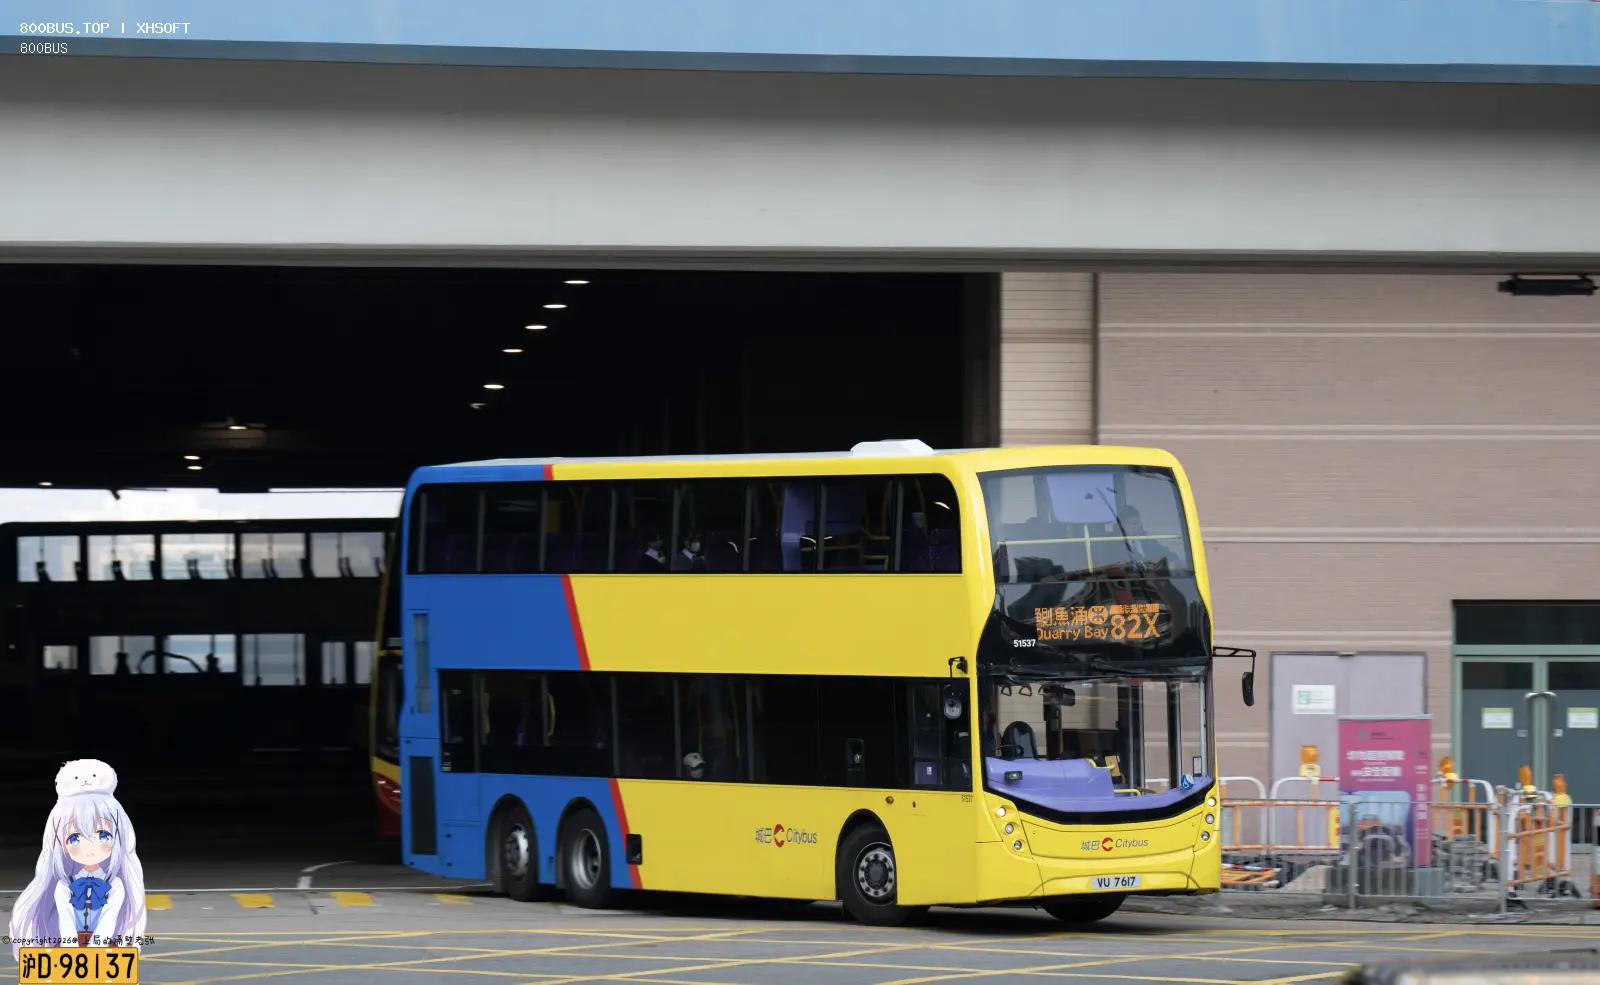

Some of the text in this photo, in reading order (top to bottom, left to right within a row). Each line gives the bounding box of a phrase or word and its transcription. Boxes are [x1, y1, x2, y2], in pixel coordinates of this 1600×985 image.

[1084, 625, 1108, 640] Bay
[1110, 613, 1161, 639] 82X
[1013, 639, 1036, 648] 51537
[755, 827, 773, 844] 城巴
[786, 827, 818, 845] Citybus
[1080, 840, 1100, 851] 城巴
[1115, 838, 1149, 849] Citybus
[1097, 876, 1136, 888] VU 7617
